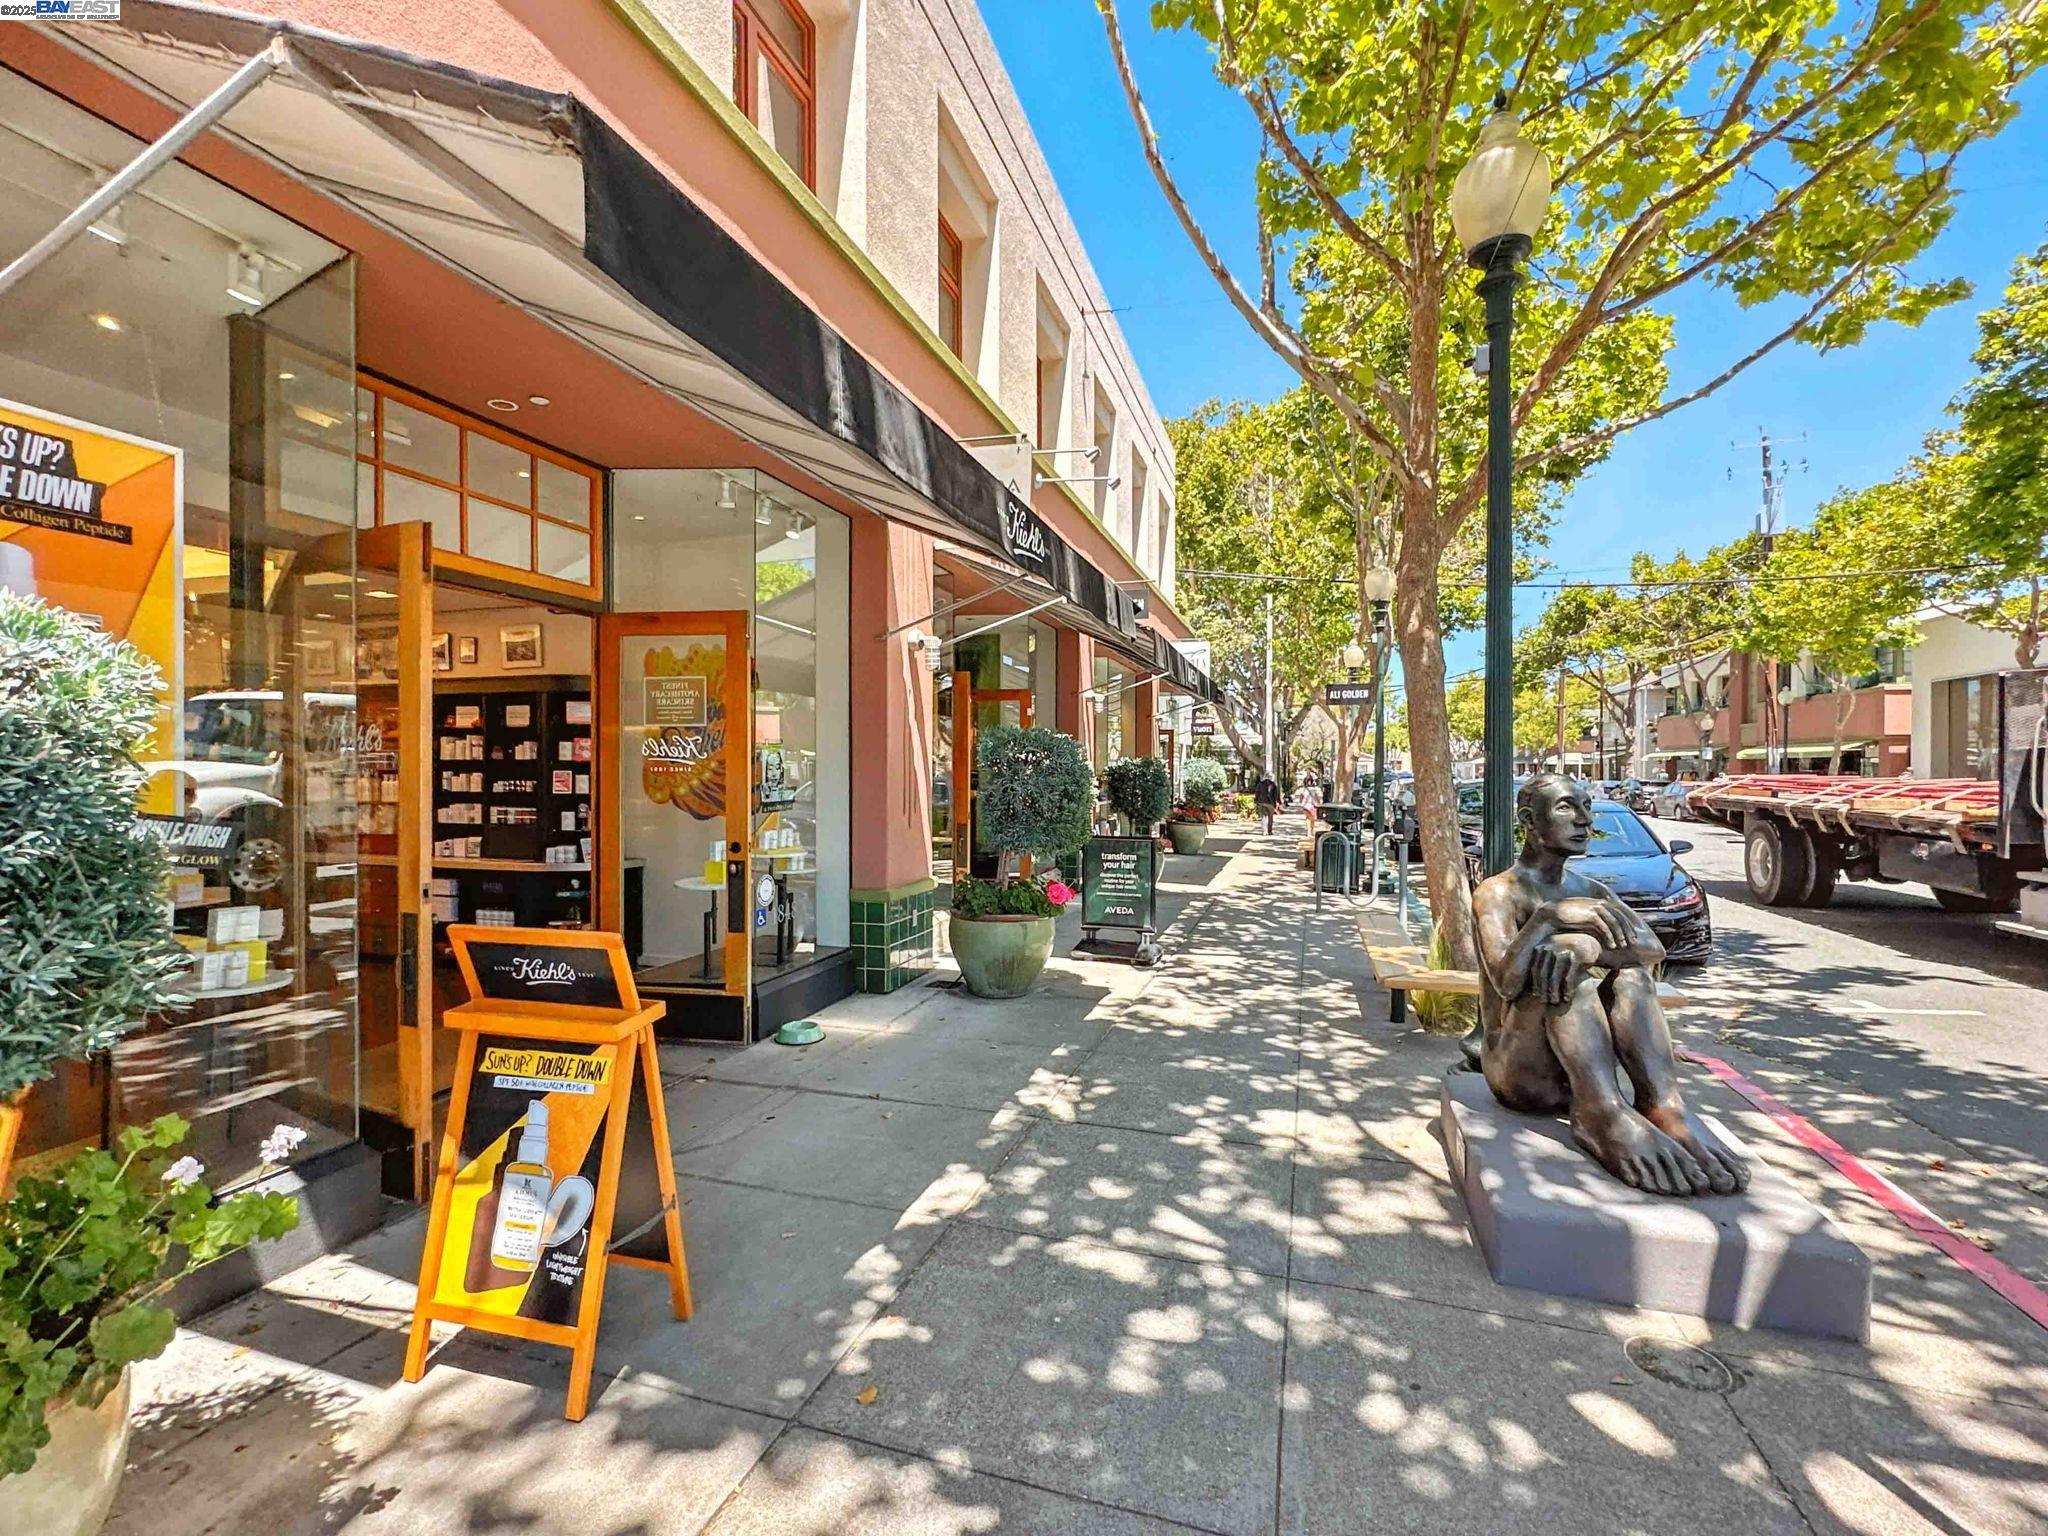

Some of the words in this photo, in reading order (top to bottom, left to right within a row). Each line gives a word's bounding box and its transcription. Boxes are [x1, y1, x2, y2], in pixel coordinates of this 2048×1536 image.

[21, 433, 65, 470] UP?
[18, 469, 93, 513] DOWN
[1, 504, 69, 527] Collagen
[73, 517, 124, 539] Peptide
[1007, 501, 1045, 558] Kiehl's
[1330, 690, 1341, 699] ALI
[1342, 689, 1369, 699] GOLDEN
[184, 823, 233, 849] FINISH
[180, 854, 222, 865] GLOW
[1101, 852, 1138, 861] transform
[1102, 862, 1120, 870] your
[1120, 861, 1136, 869] hair
[1104, 906, 1135, 915] AVEDA
[512, 957, 577, 982] Kiehl's
[486, 1051, 512, 1071] SUN'S
[513, 1053, 533, 1074] UP?
[535, 1055, 576, 1078] DOUBLE
[574, 1058, 607, 1082] DOWN
